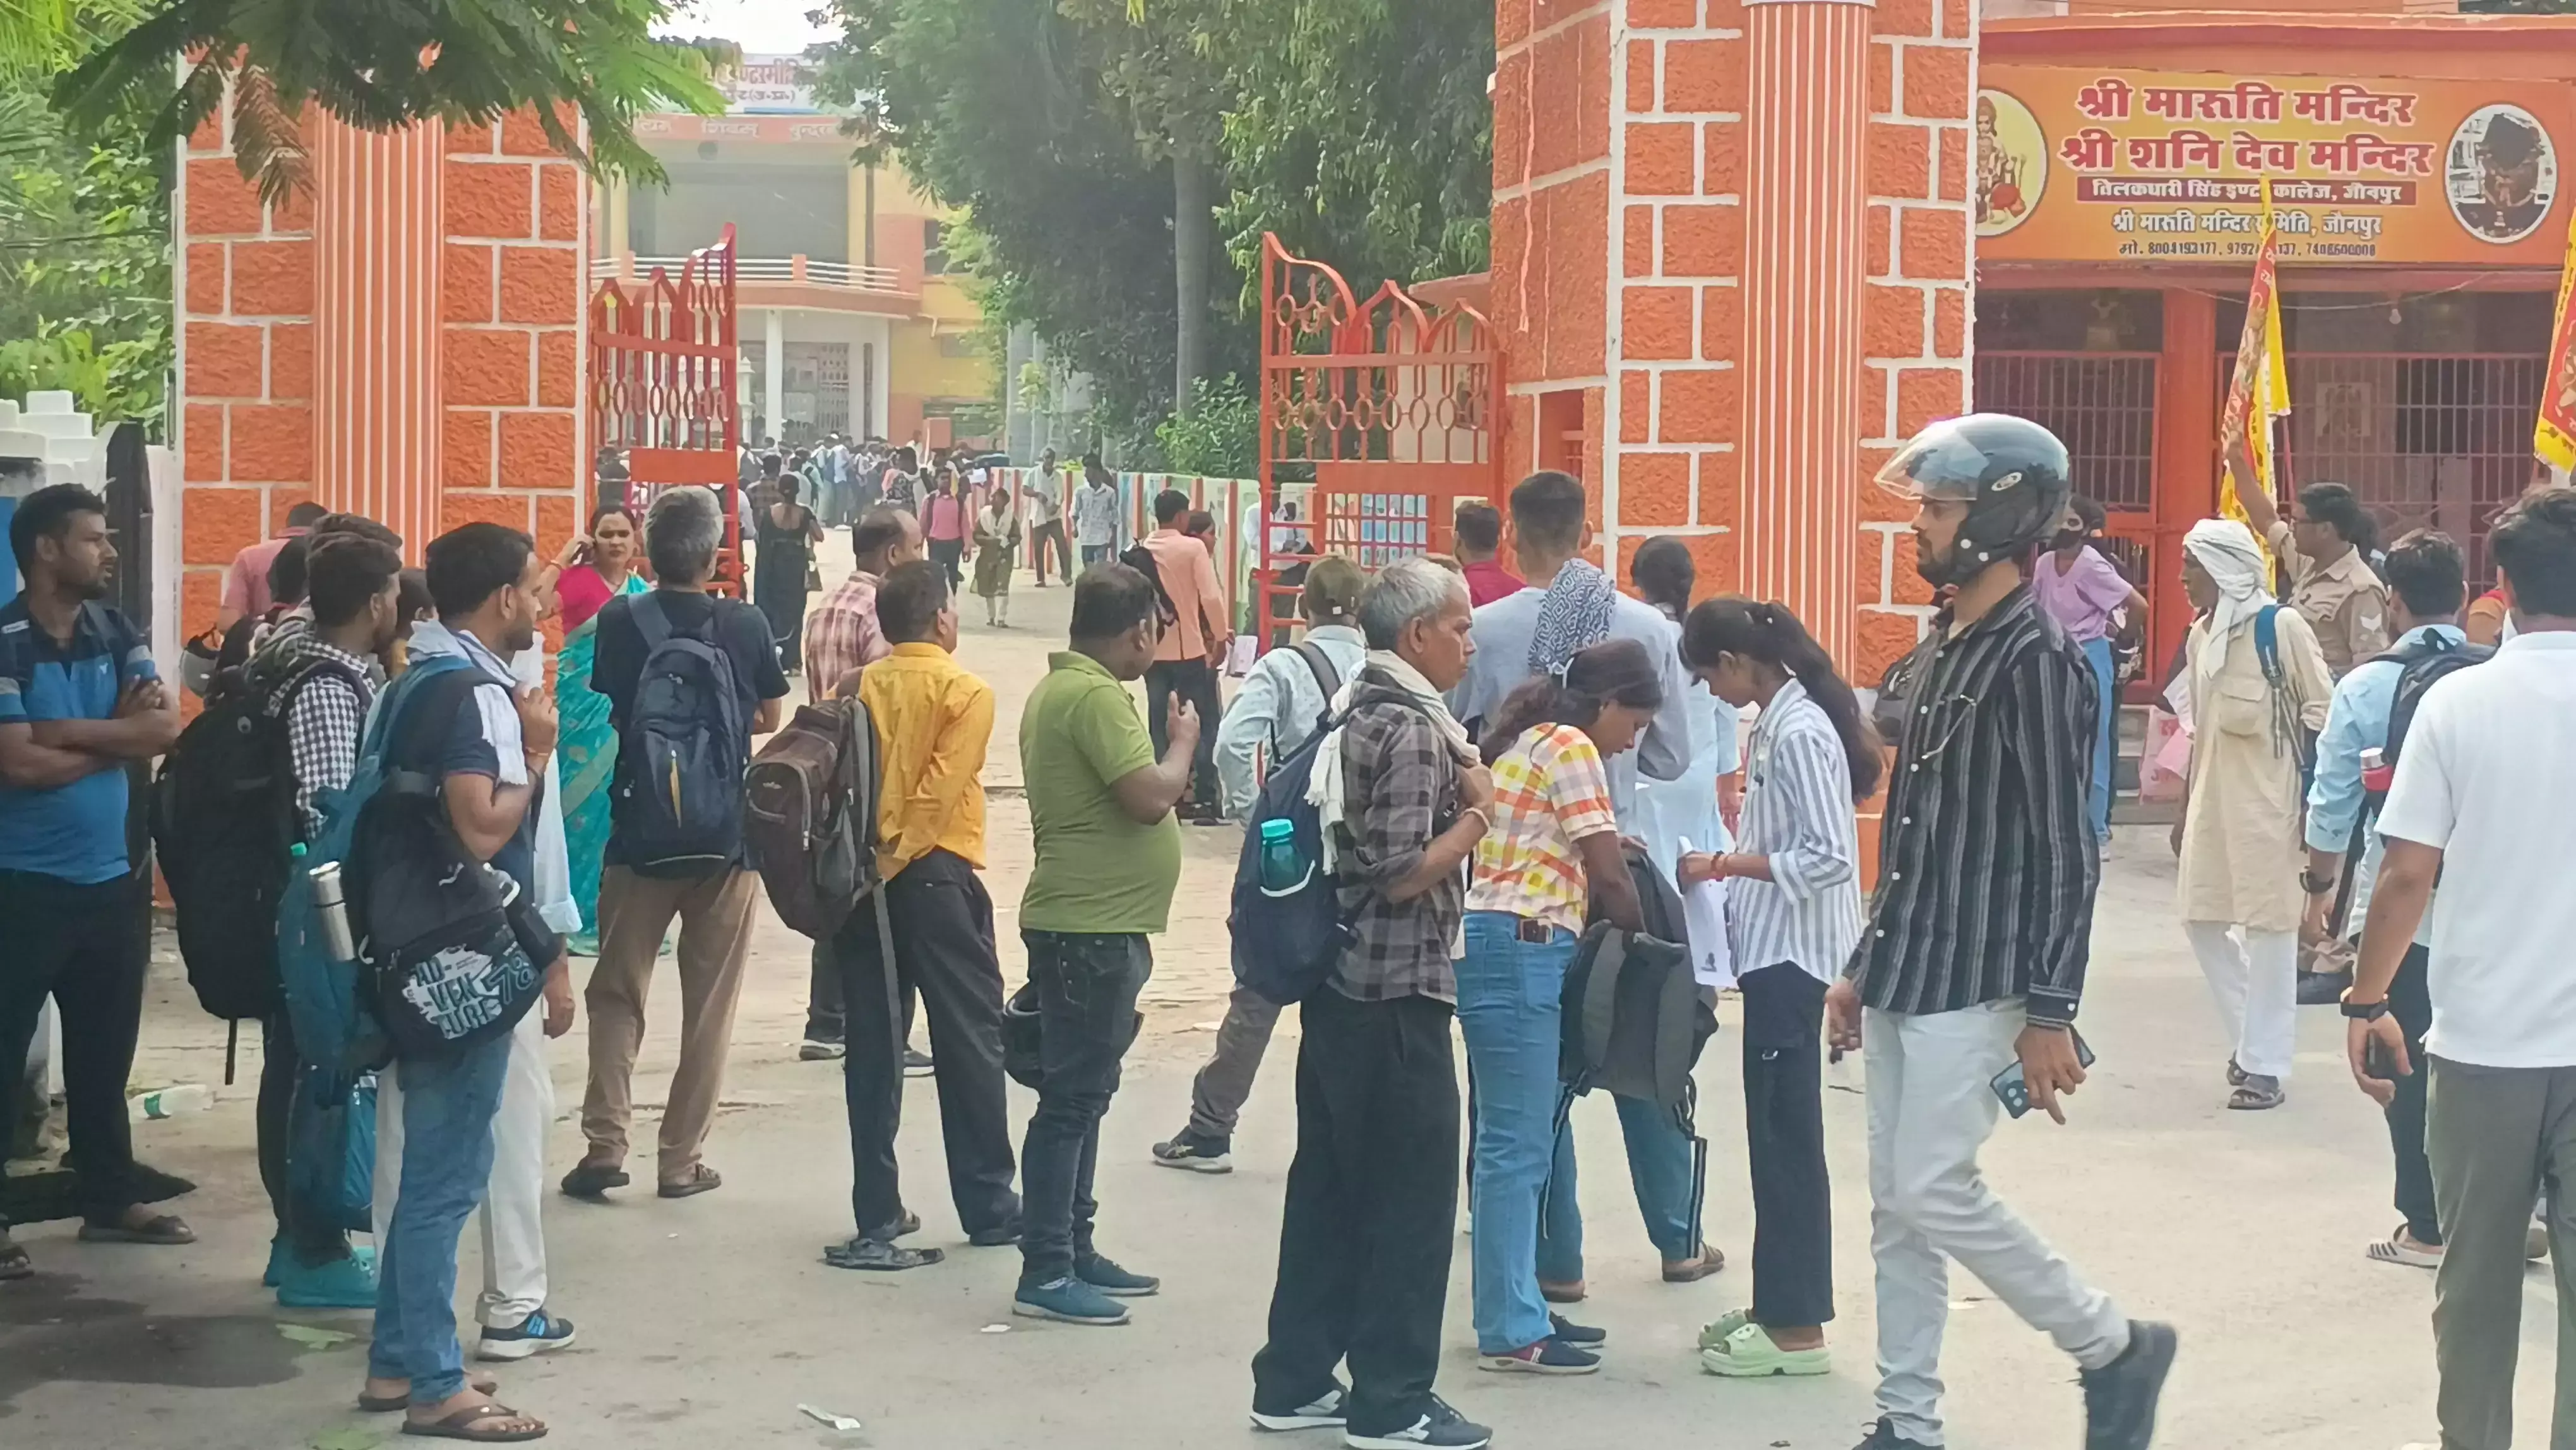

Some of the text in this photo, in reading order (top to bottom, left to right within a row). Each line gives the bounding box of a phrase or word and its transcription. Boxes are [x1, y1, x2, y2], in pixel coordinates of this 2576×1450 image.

[2076, 77, 2134, 119] श्री
[2292, 83, 2418, 124] मन्दिर
[2059, 128, 2436, 174] श्री शनि देव मन्दिर
[2092, 179, 2182, 197] तिलकधारी
[2187, 179, 2222, 198] सिंह
[2226, 183, 2260, 200] इण्ट
[2342, 182, 2402, 205] जौनपुर
[2113, 208, 2135, 232] श्री
[2200, 209, 2252, 232] मन्दिर
[2322, 211, 2383, 240] जौनपुर
